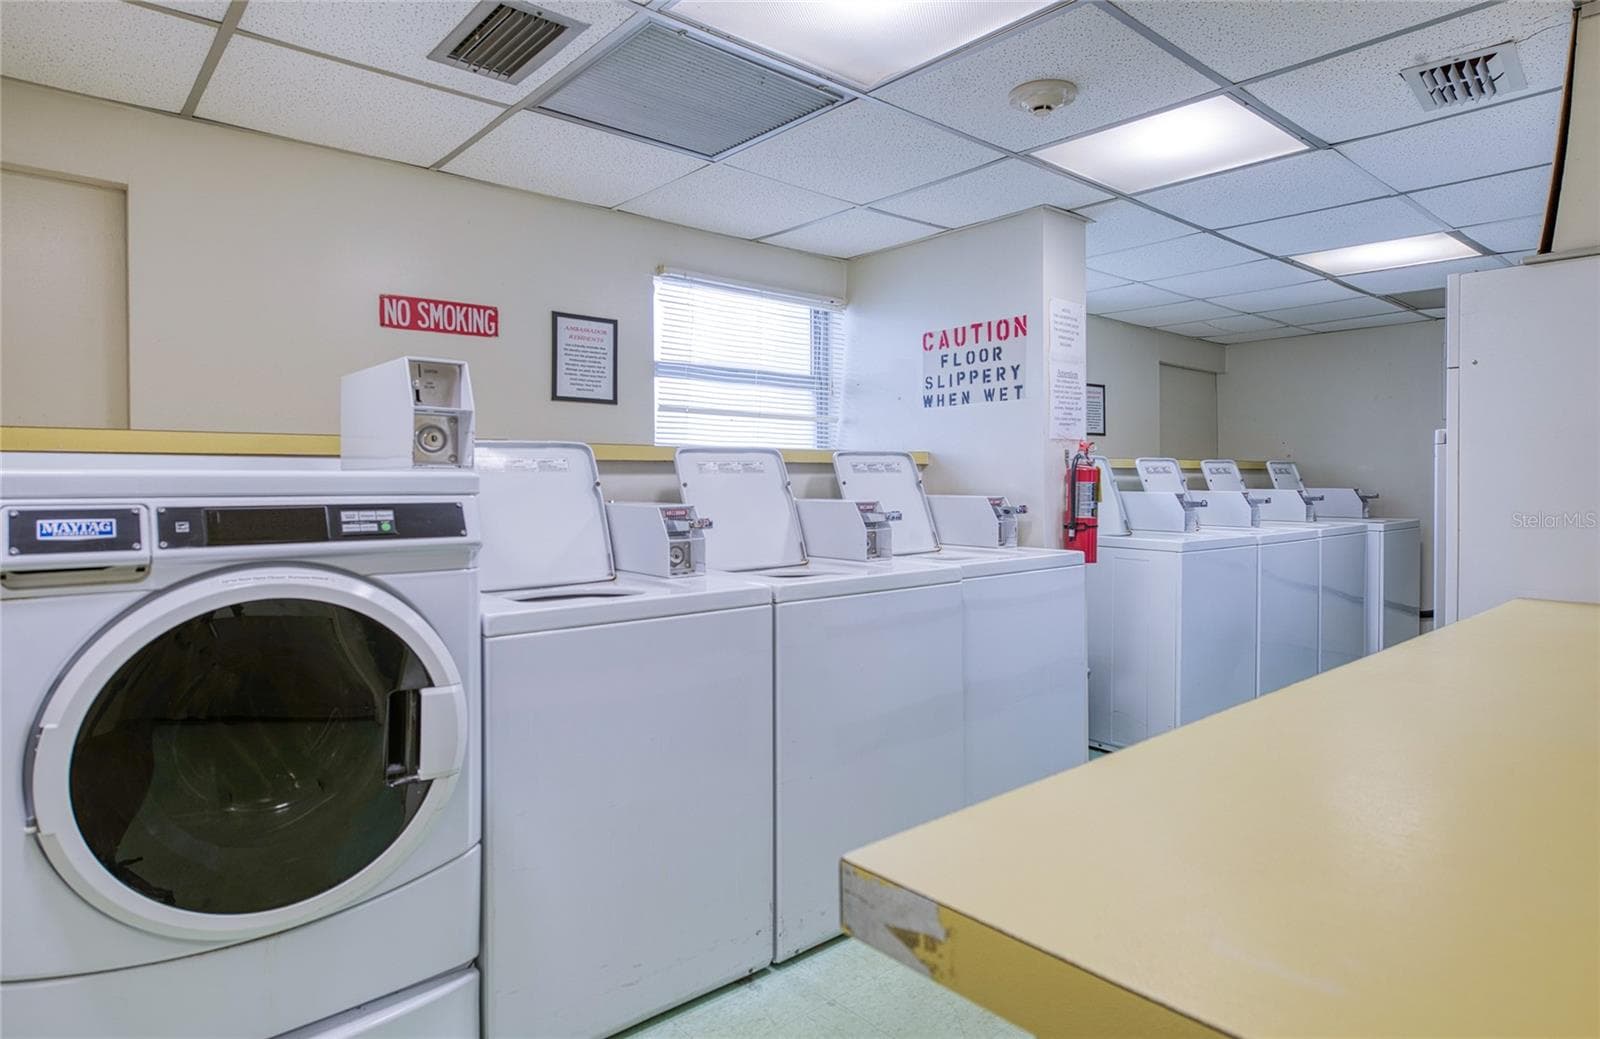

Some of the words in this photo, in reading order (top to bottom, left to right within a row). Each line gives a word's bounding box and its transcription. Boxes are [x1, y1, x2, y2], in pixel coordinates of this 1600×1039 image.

[384, 298, 411, 326] NO
[417, 301, 496, 335] SMOKING
[922, 314, 1028, 352] CAUTION
[941, 346, 1003, 368] FLOOR
[925, 364, 1021, 390] SLIPPERY
[923, 390, 970, 408] WHEN
[984, 385, 1024, 402] WET
[41, 521, 112, 535] MAYTAG
